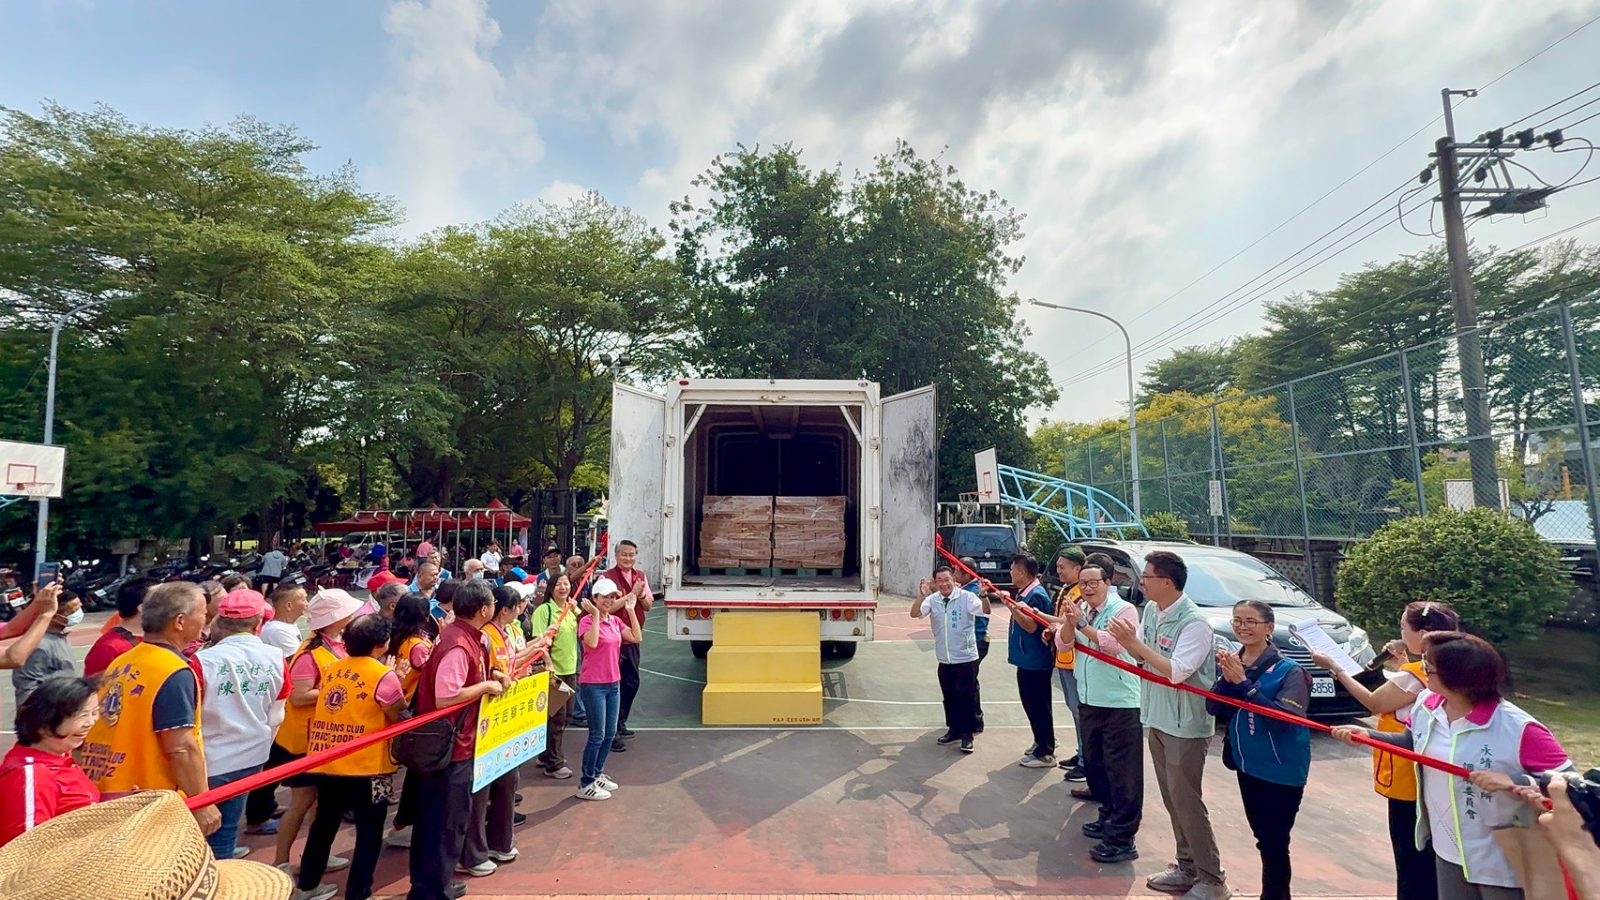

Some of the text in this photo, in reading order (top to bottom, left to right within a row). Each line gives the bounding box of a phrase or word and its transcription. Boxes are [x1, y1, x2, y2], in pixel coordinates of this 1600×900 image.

[346, 724, 365, 734] CLUB
[1462, 761, 1478, 820] 調委員會
[1480, 744, 1493, 803] 永靖所
